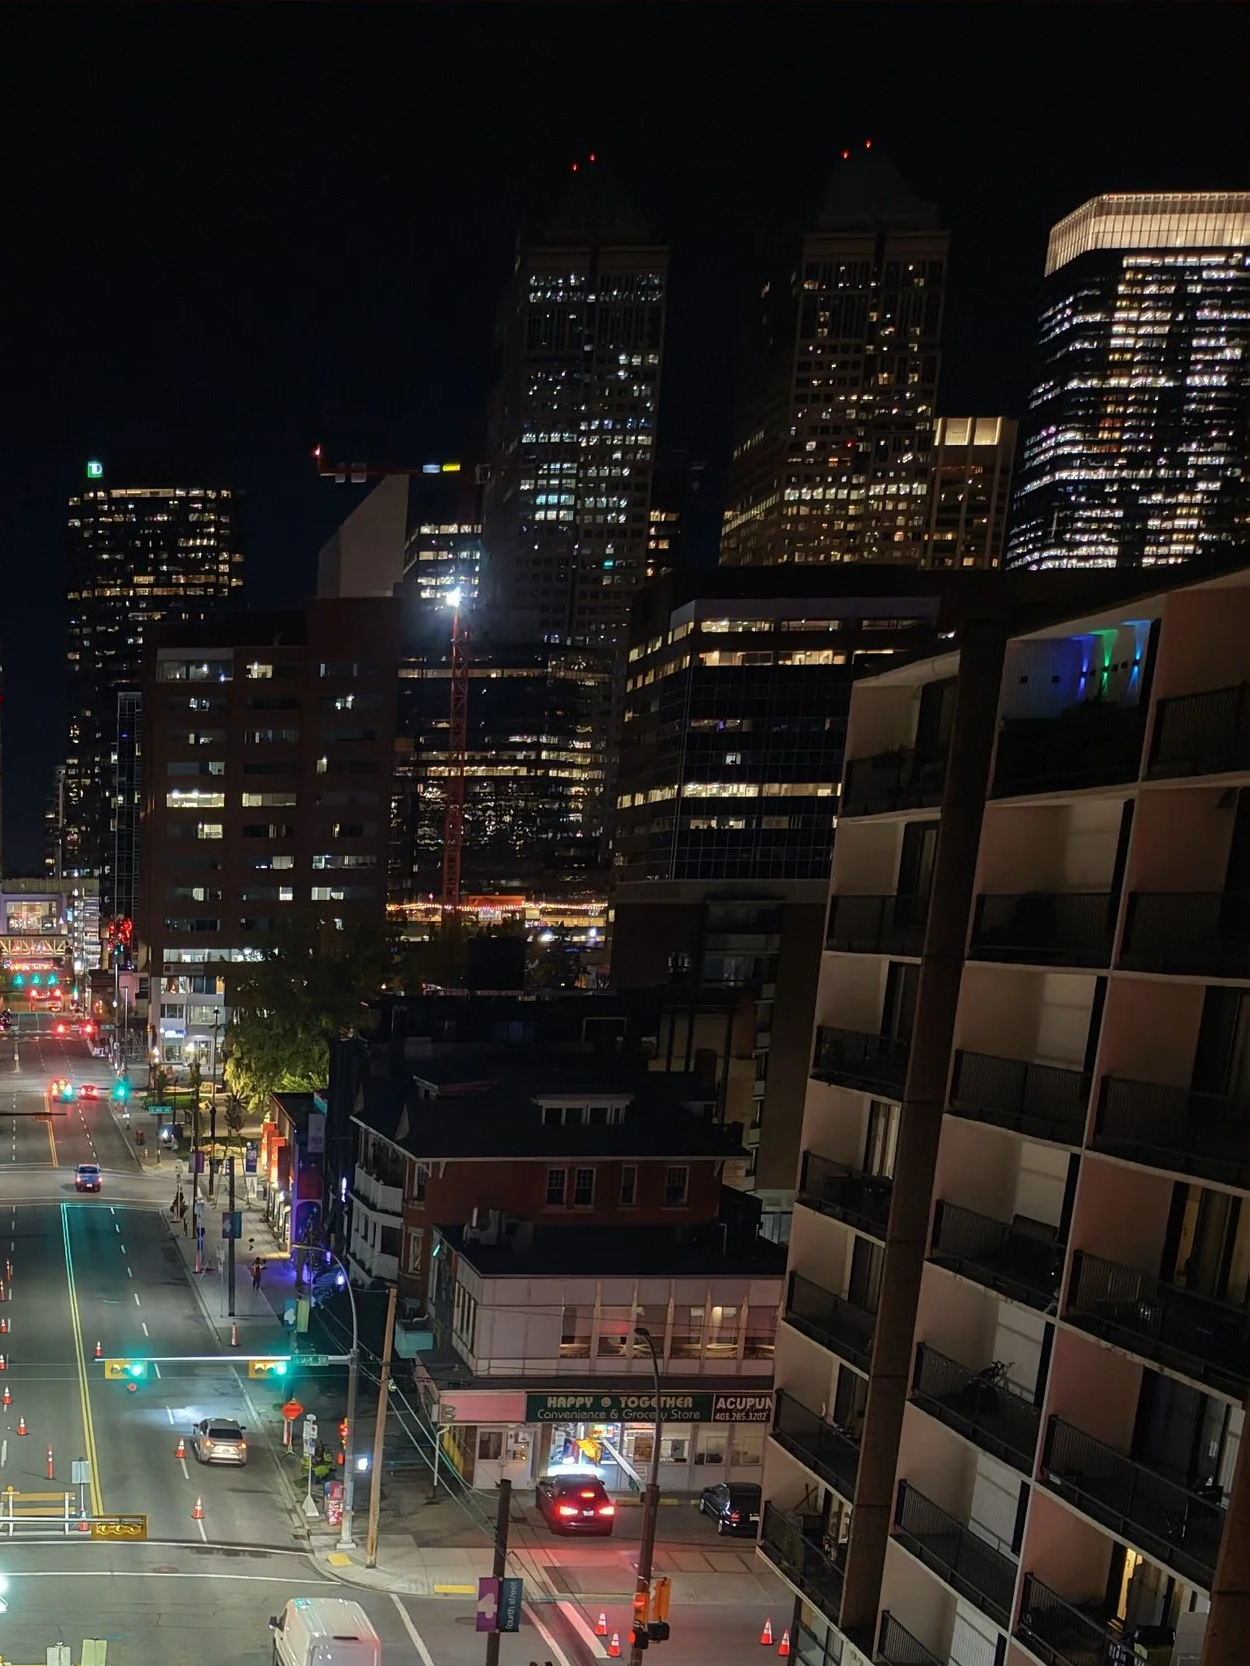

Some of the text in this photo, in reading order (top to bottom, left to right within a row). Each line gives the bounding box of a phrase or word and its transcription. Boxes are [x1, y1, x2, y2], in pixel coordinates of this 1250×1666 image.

[547, 1396, 594, 1408] HAPPY
[537, 1408, 701, 1421] Convenience & Grocey Store
[715, 1412, 767, 1421] 403.265.3202
[477, 1592, 498, 1619] 4
[505, 1605, 516, 1630] fourth
